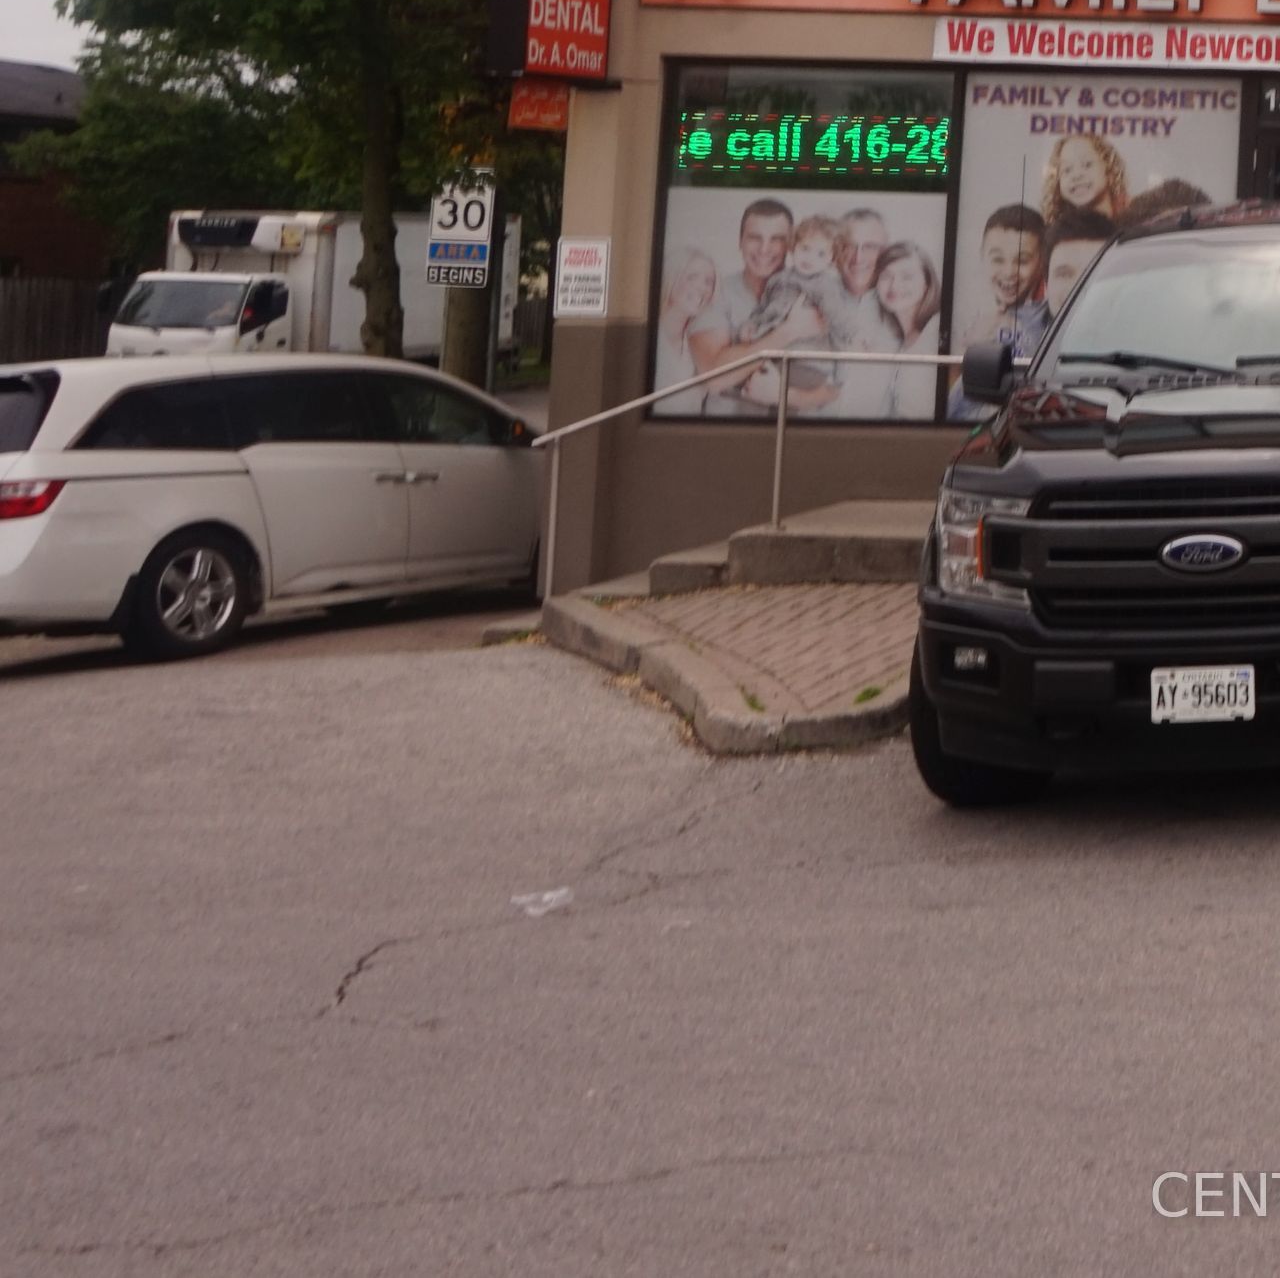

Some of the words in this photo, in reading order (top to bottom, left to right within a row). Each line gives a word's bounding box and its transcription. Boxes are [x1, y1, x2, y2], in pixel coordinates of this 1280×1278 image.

[946, 20, 995, 54] We
[1007, 22, 1154, 59] Welcome
[528, 38, 547, 65] Dr.
[550, 41, 564, 68] A.
[566, 42, 603, 71] Omar
[971, 84, 1073, 107] FAMILY
[1078, 86, 1094, 107] &
[1103, 87, 1239, 111] COSMETIC
[1029, 114, 1178, 137] DENTISTRY
[727, 122, 801, 161] call
[437, 199, 486, 231] 30
[435, 243, 480, 260] AREA
[428, 267, 484, 285] BEGINS
[1157, 683, 1178, 710] AY
[1191, 682, 1249, 709] 95603
